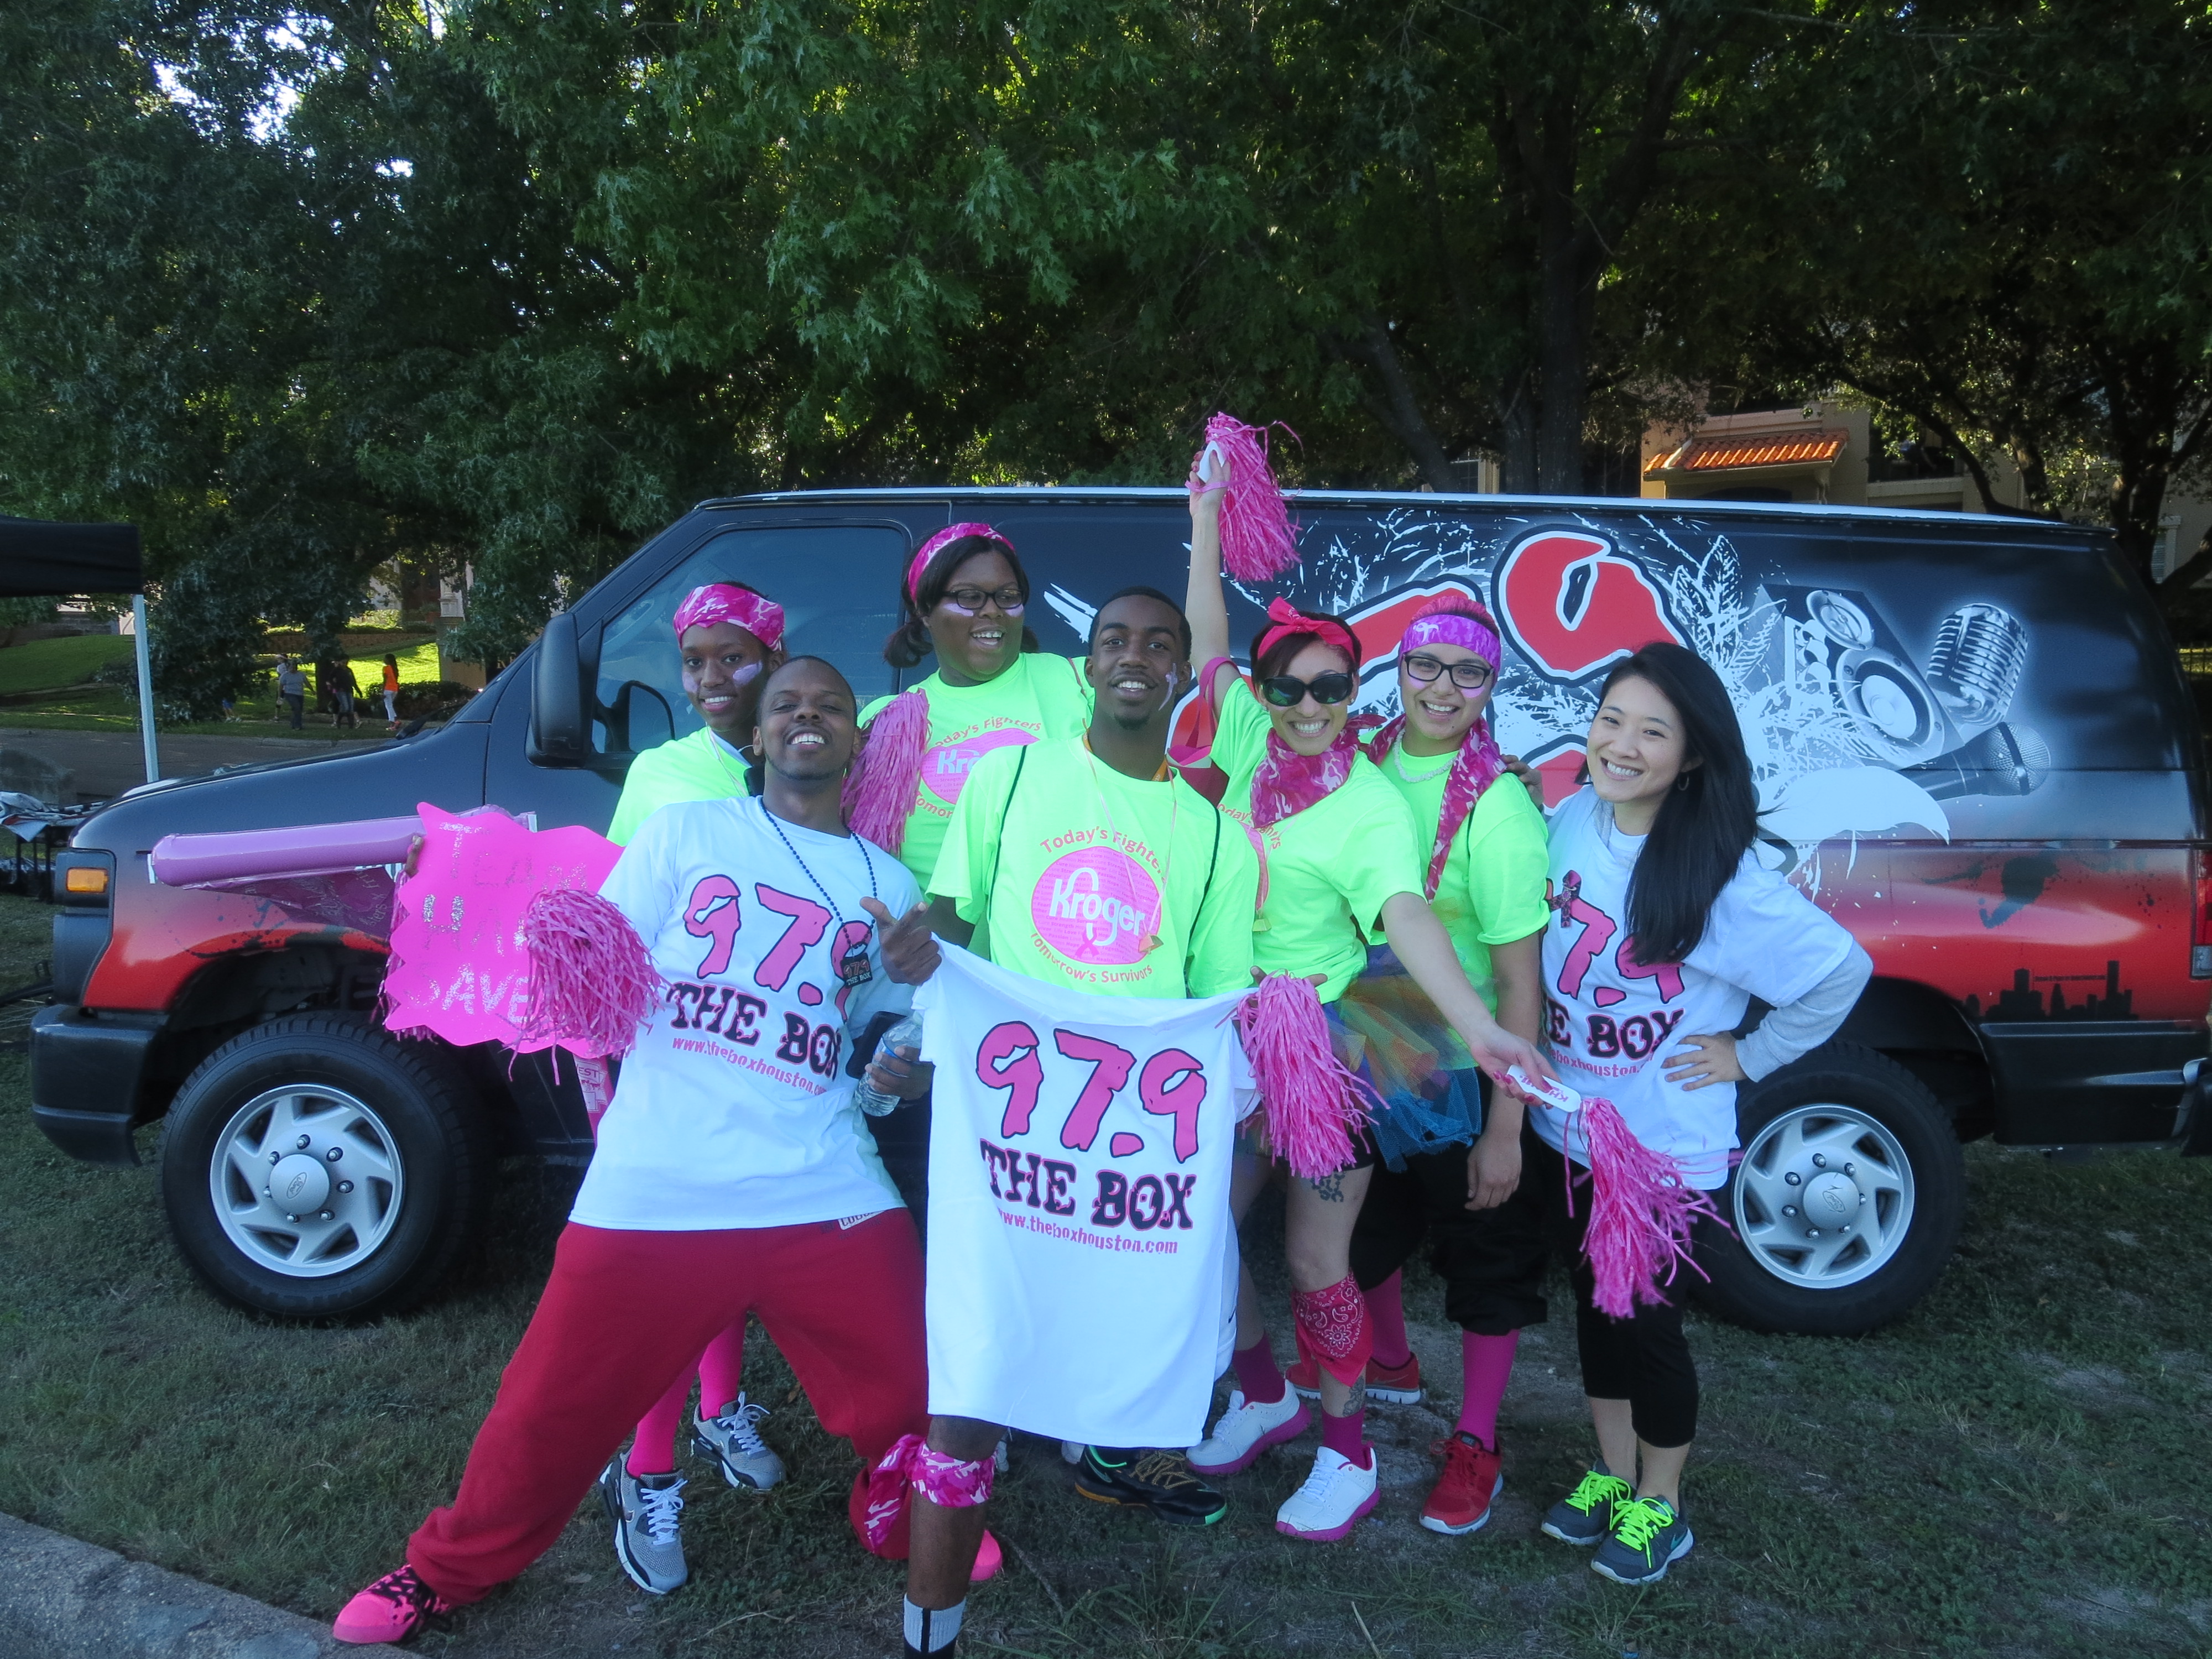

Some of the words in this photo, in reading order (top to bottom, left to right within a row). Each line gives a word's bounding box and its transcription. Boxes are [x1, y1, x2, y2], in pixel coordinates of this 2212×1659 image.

[935, 724, 979, 747] oday's
[1040, 826, 1108, 853] Today's
[1049, 867, 1145, 946] Kroger
[843, 959, 870, 978] 97.9
[846, 976, 859, 986] THE
[859, 972, 872, 981] BOX
[1101, 964, 1152, 983] Survivors
[666, 982, 768, 1047] THE
[775, 1011, 842, 1082] BOX
[975, 1020, 1207, 1164] 97.9
[979, 1137, 1076, 1217] THE
[1090, 1169, 1197, 1232] BOX
